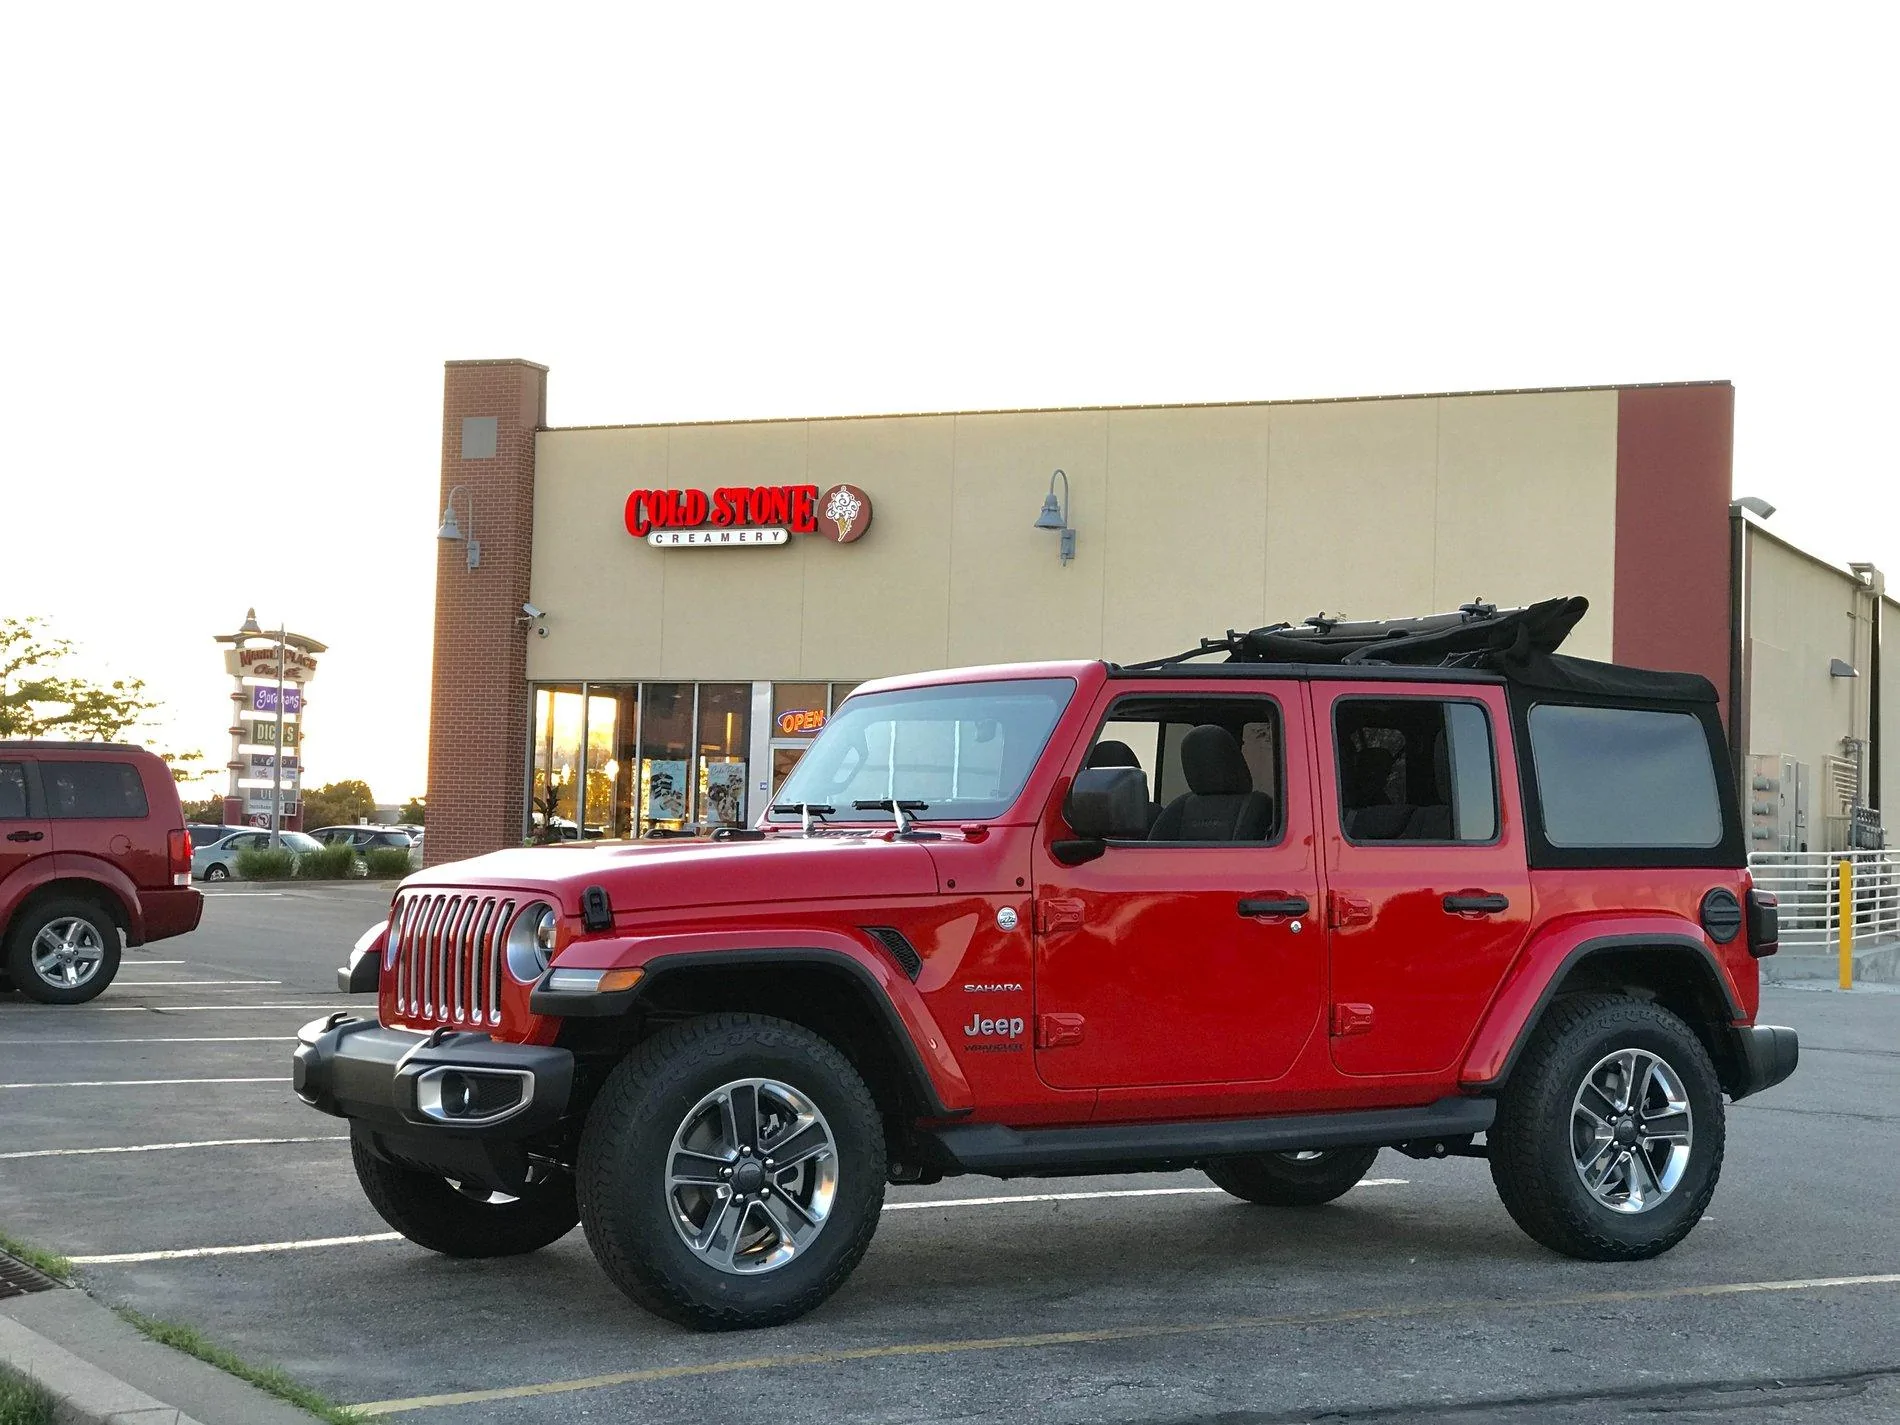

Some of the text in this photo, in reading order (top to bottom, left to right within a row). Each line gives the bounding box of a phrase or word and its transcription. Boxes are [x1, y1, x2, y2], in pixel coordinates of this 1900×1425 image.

[624, 484, 819, 537] COLD STONE
[655, 531, 781, 544] CREAMERY
[782, 709, 824, 733] OPEN
[260, 789, 285, 800] ULA
[964, 983, 1023, 992] SAHARA
[964, 1013, 1024, 1039] Jeep
